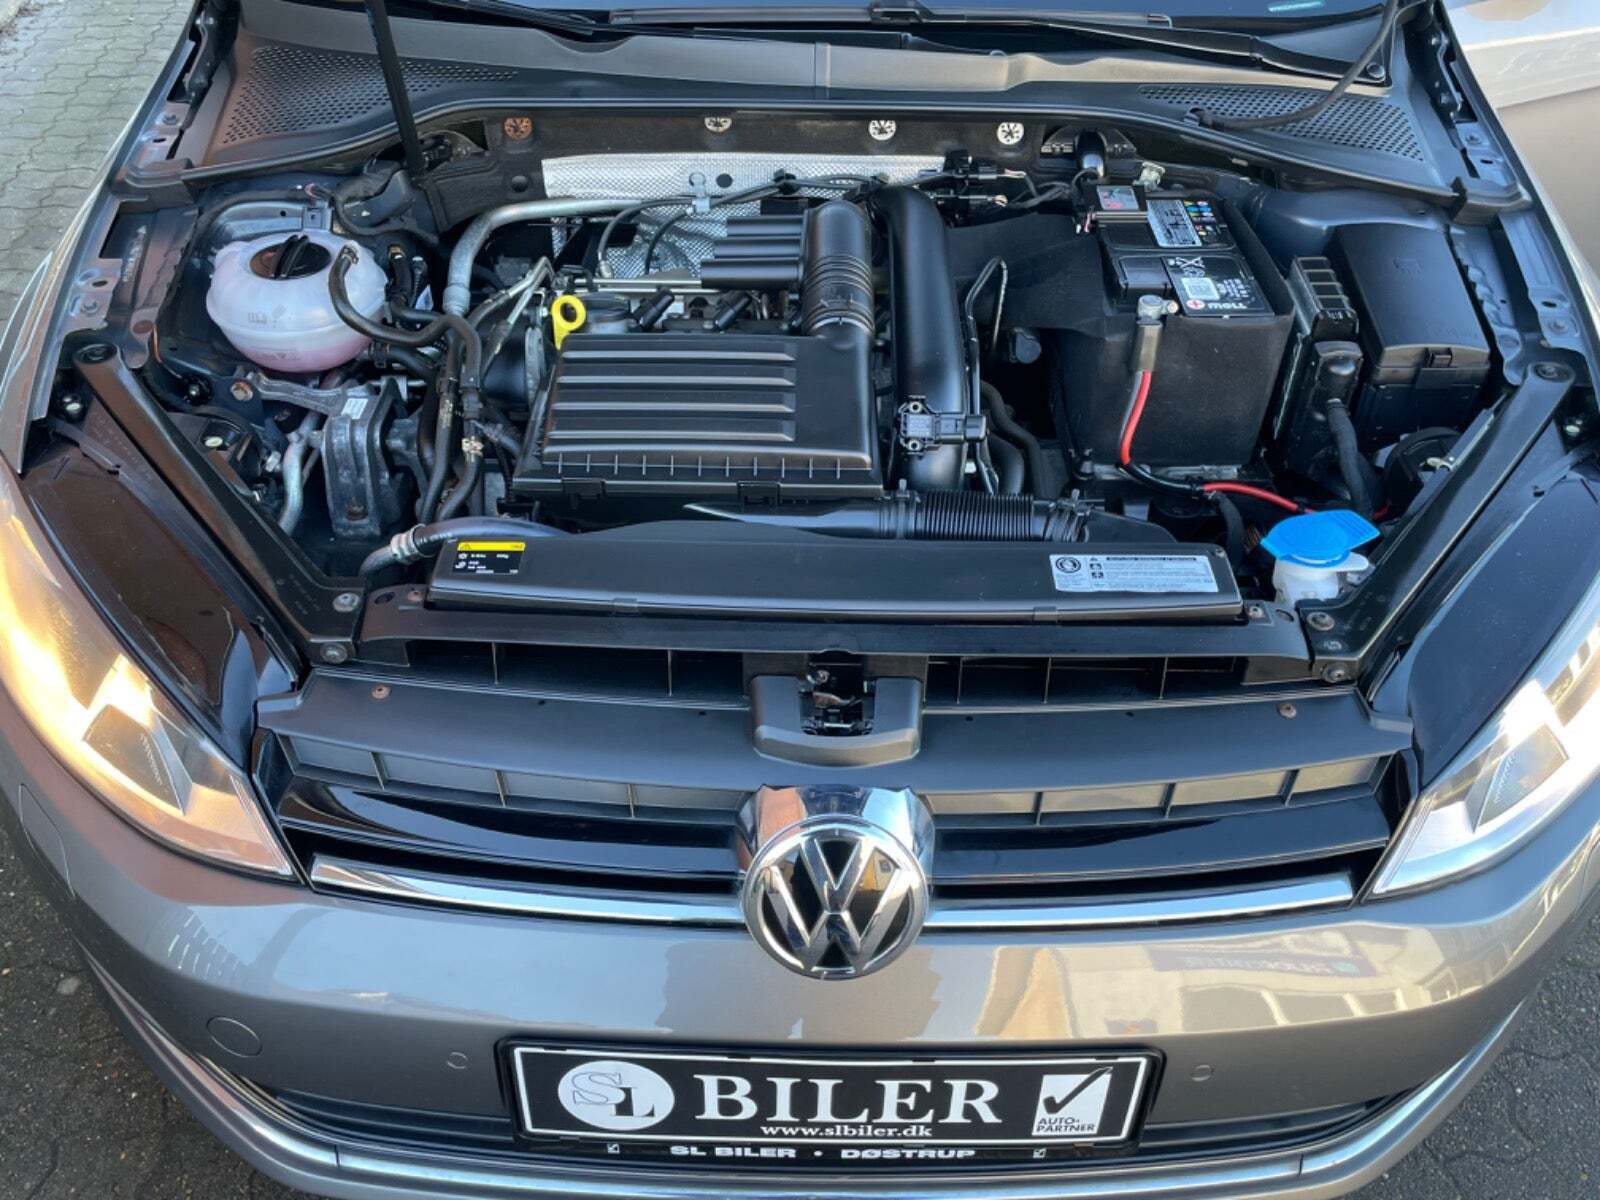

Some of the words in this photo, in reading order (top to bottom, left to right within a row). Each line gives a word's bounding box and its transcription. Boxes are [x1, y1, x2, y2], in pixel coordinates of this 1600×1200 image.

[693, 1073, 1002, 1124] BILER
[760, 1124, 933, 1138] www.slbiler.dk
[1036, 1124, 1095, 1133] PARTNER
[669, 1145, 706, 1156] SL
[714, 1146, 797, 1158] BILER
[840, 1149, 976, 1160] DØSTRUP
